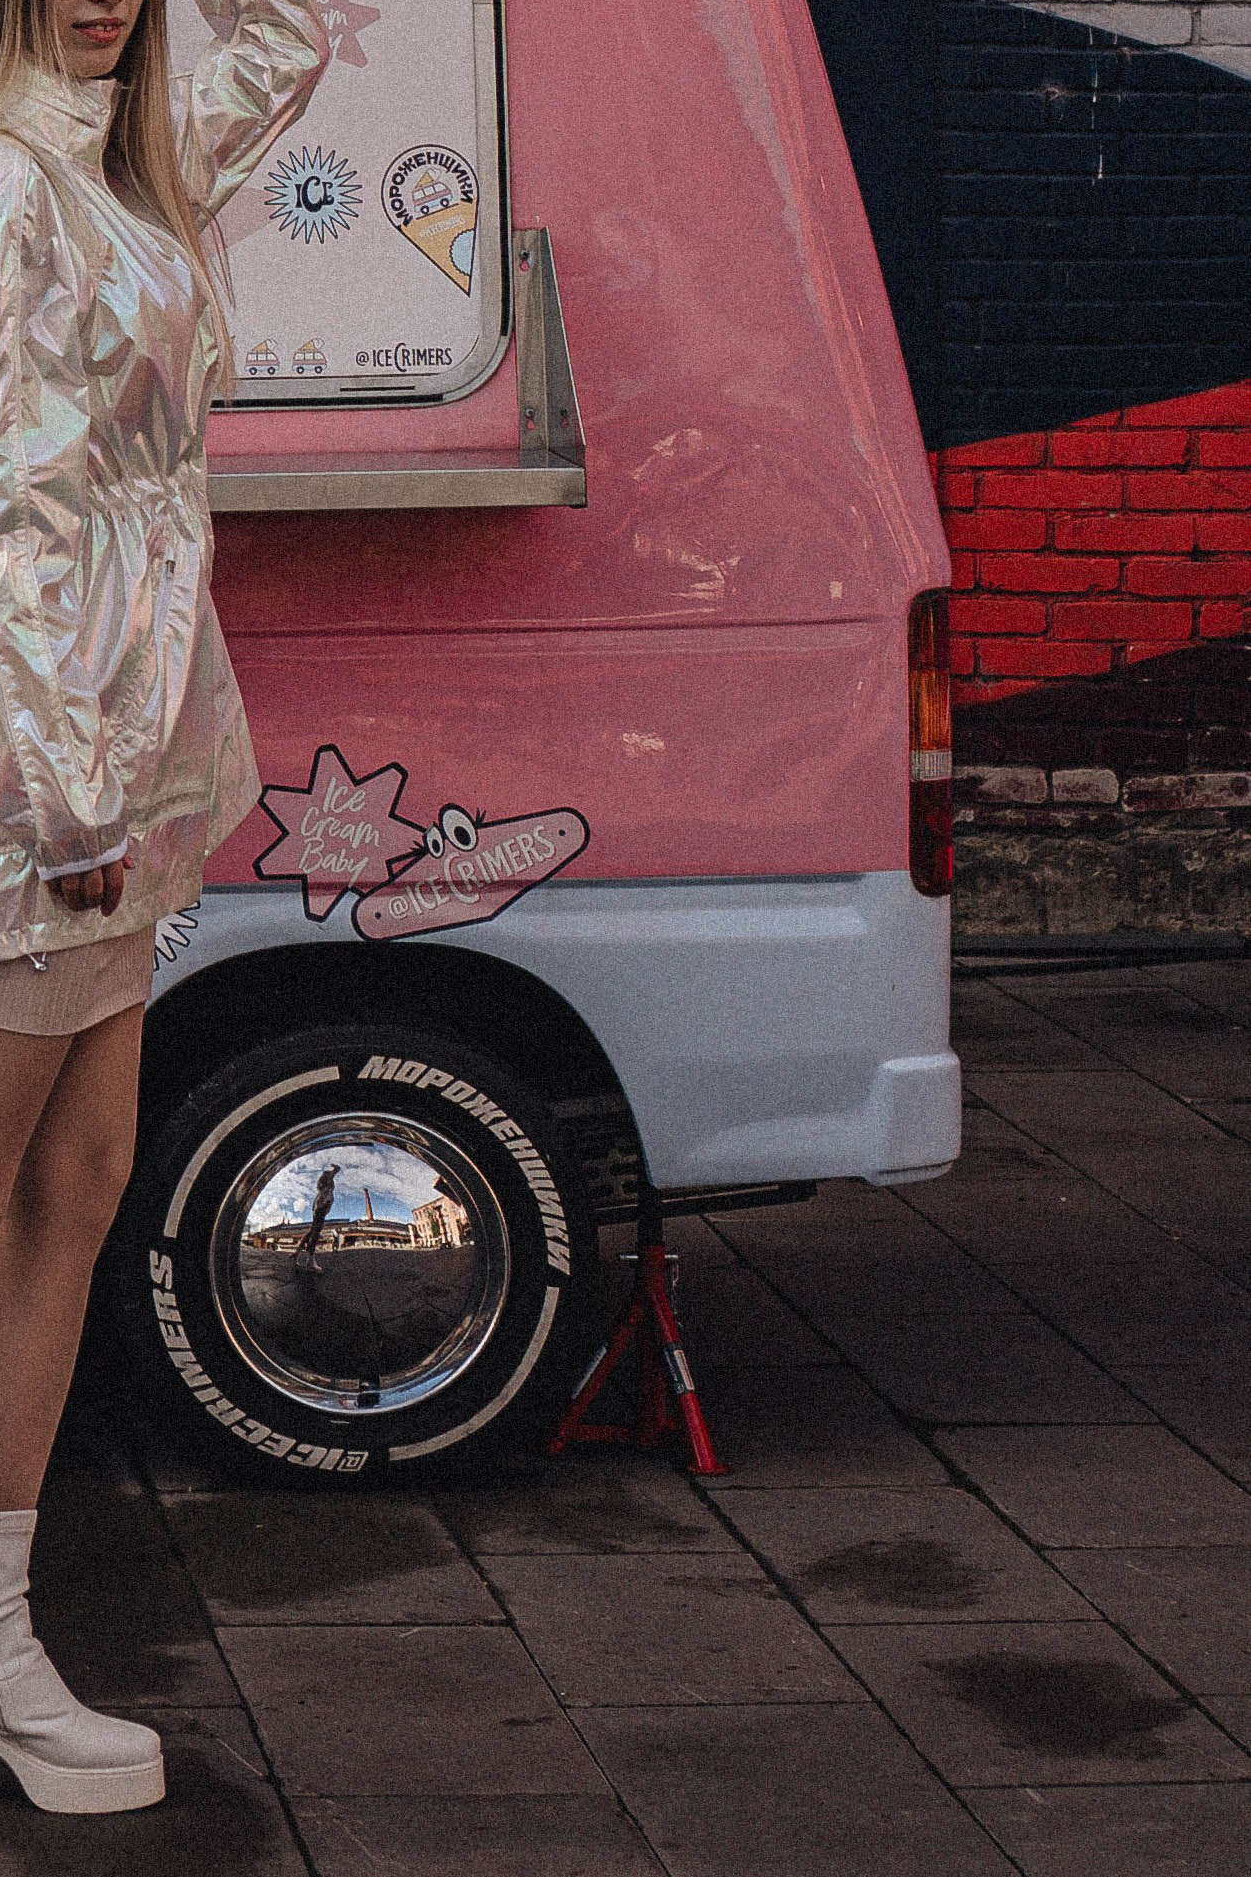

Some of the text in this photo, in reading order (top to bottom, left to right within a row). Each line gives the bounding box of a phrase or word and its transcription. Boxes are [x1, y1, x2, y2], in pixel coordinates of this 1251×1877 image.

[294, 175, 335, 213] ICE
[389, 151, 474, 227] МОРОЖЕНЩИКИ
[322, 776, 367, 813] Ice
[300, 806, 381, 849] Cream
[298, 837, 369, 885] Baby
[358, 1055, 571, 1276] МОРОЖЕНЩИКИ
[150, 1249, 369, 1472] @ICECRIMERS
